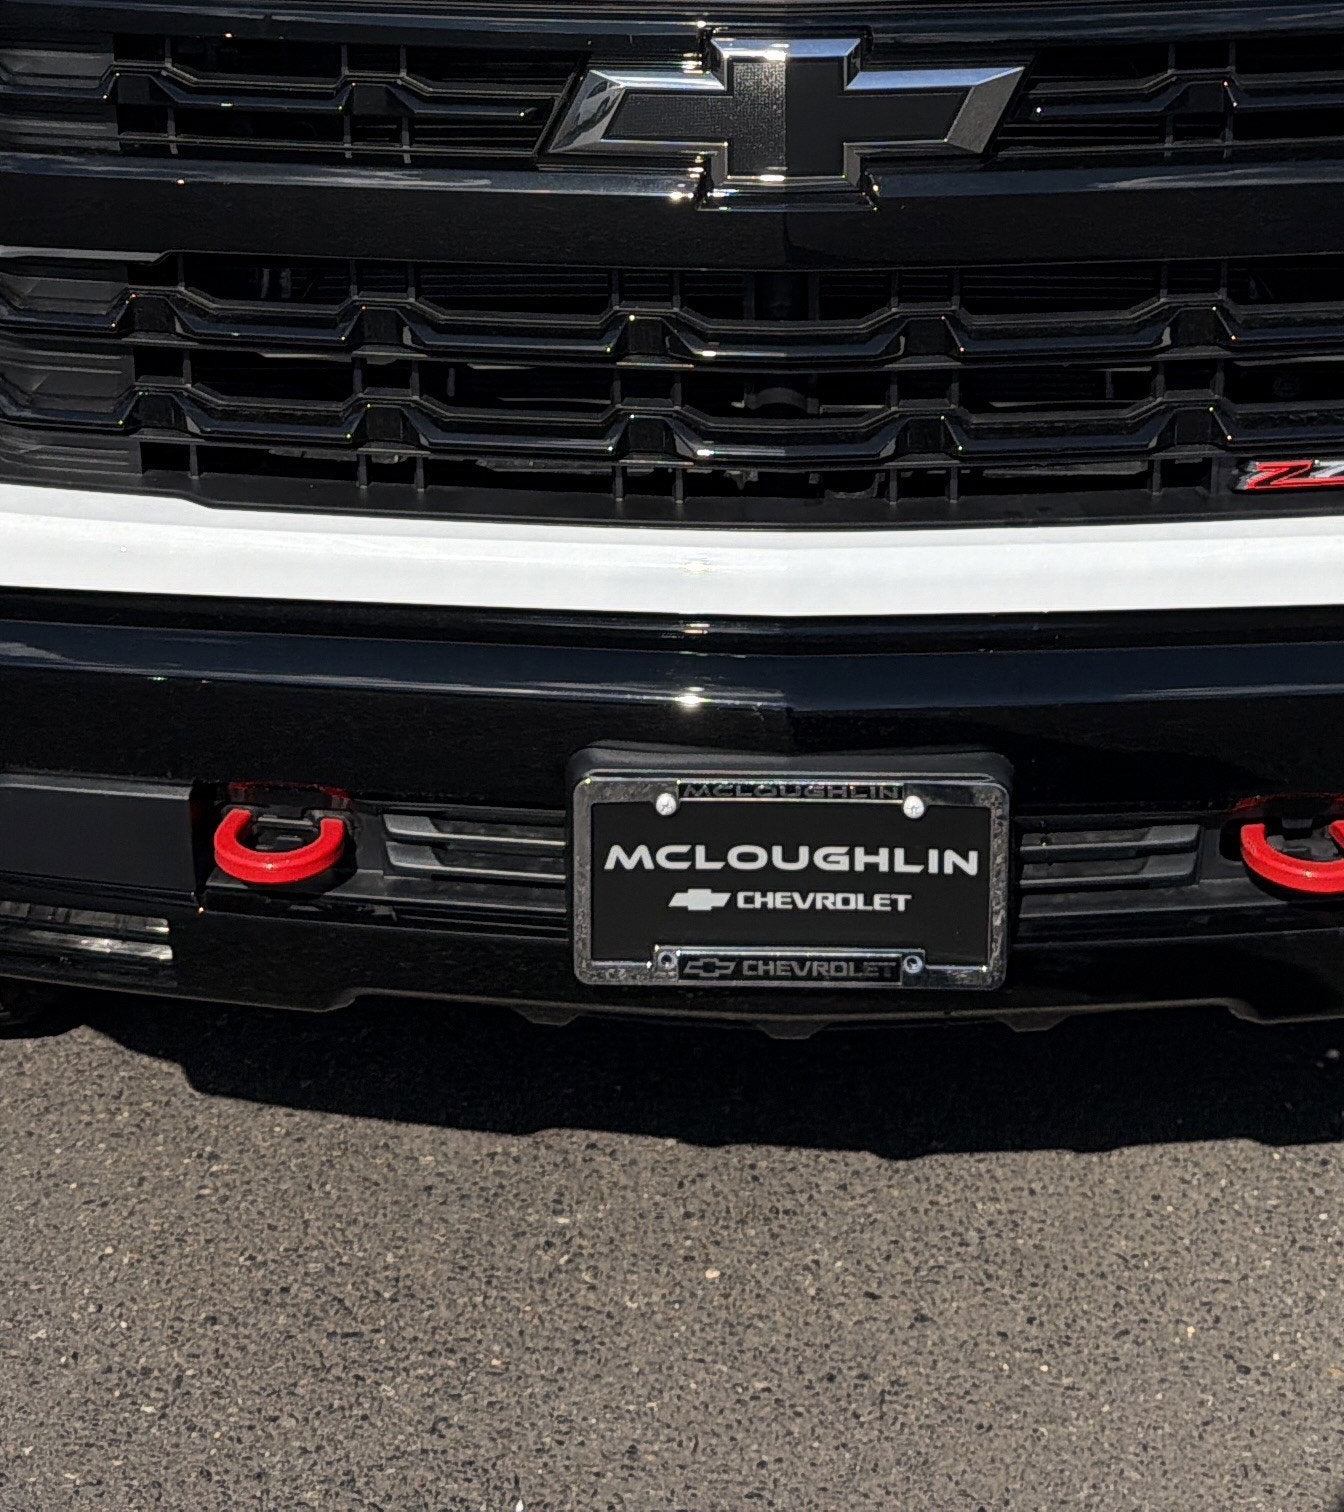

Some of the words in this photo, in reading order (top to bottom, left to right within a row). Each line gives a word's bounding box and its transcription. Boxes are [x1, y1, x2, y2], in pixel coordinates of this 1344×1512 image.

[683, 784, 899, 799] MCLOUGHLIN
[603, 844, 979, 876] MCLOUGHLIN
[737, 891, 912, 912] CHEVROLET
[741, 959, 897, 978] CHEVROLET
